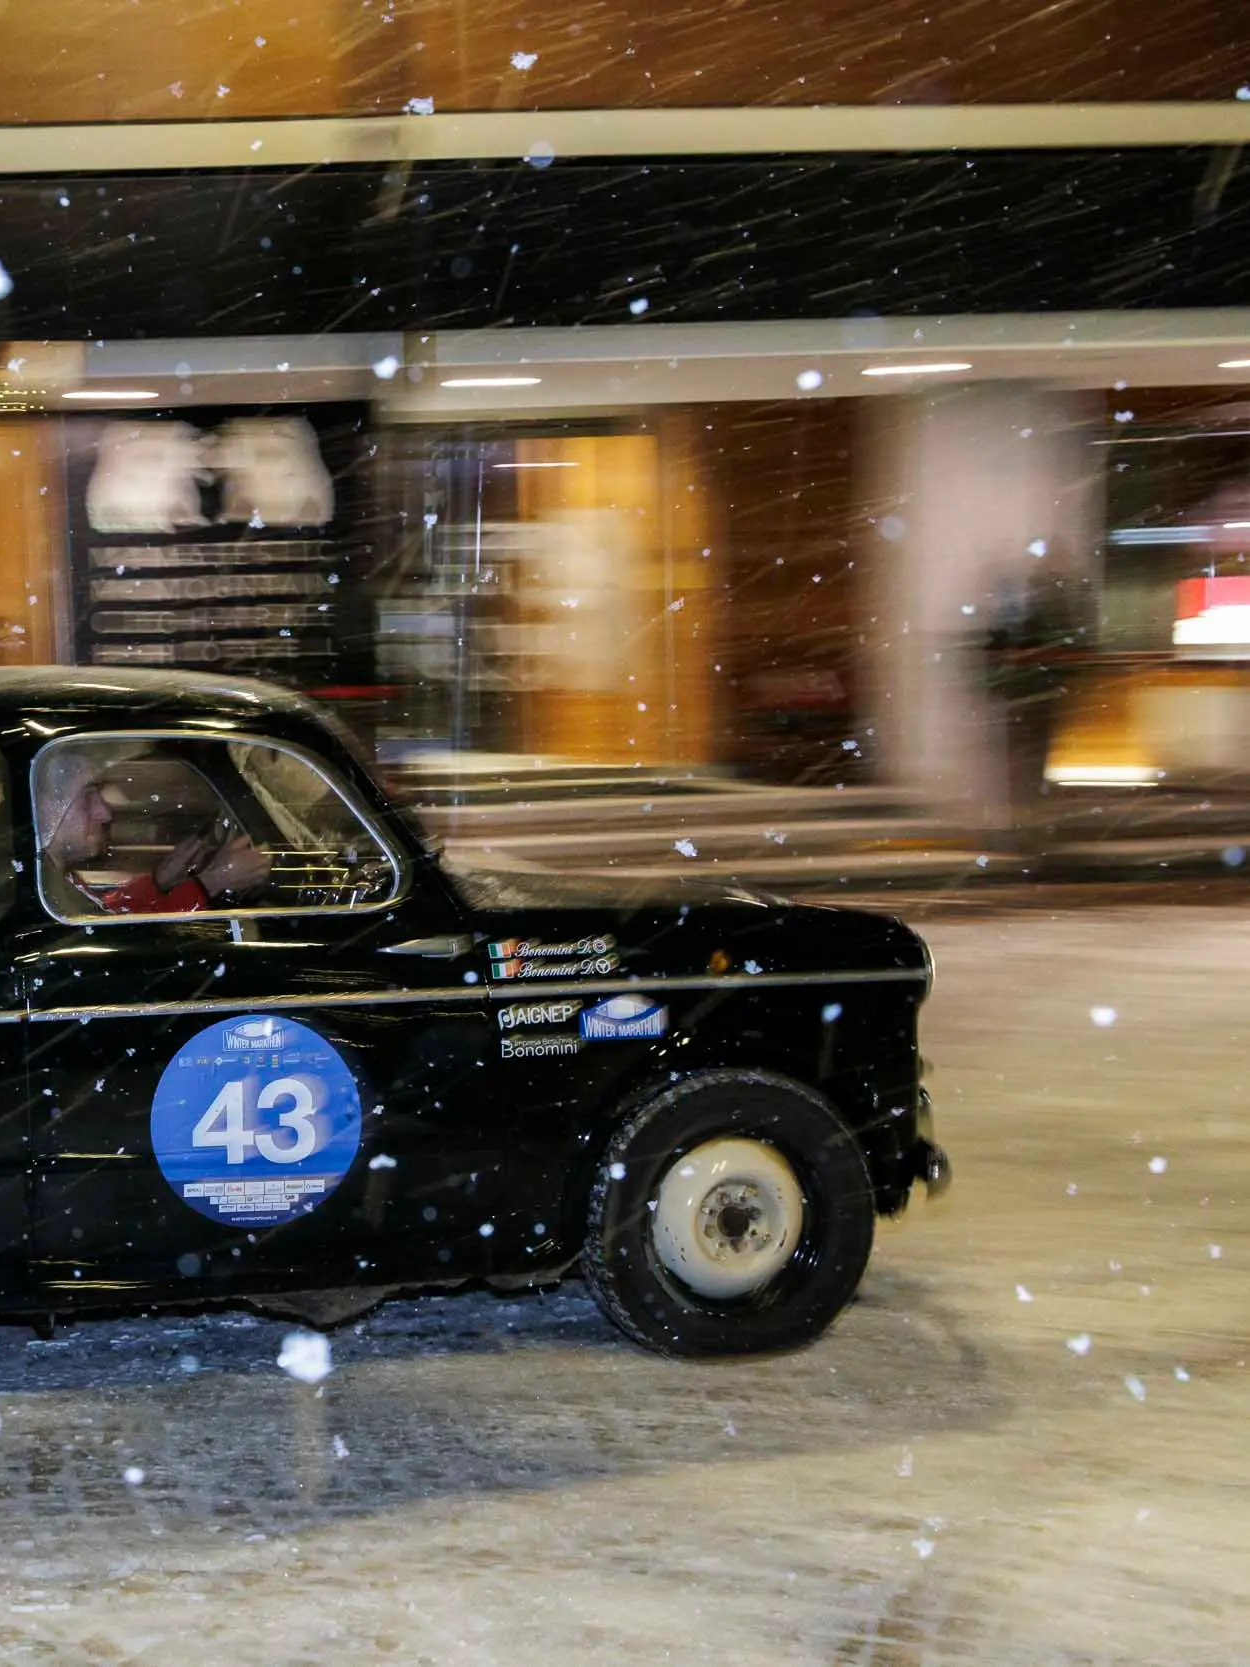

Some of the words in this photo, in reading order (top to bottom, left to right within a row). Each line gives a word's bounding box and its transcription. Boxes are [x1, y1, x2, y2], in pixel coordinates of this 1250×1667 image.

[514, 941, 573, 957] Bonomini
[517, 961, 577, 978] Bonomini
[515, 1005, 573, 1025] AIGNEP
[582, 1012, 616, 1038] WINTER
[617, 1009, 661, 1037] MARATHON
[225, 1031, 249, 1049] WINTER
[250, 1031, 281, 1049] MARATHON
[501, 1040, 578, 1059] Bonomini
[192, 1078, 317, 1165] 43
